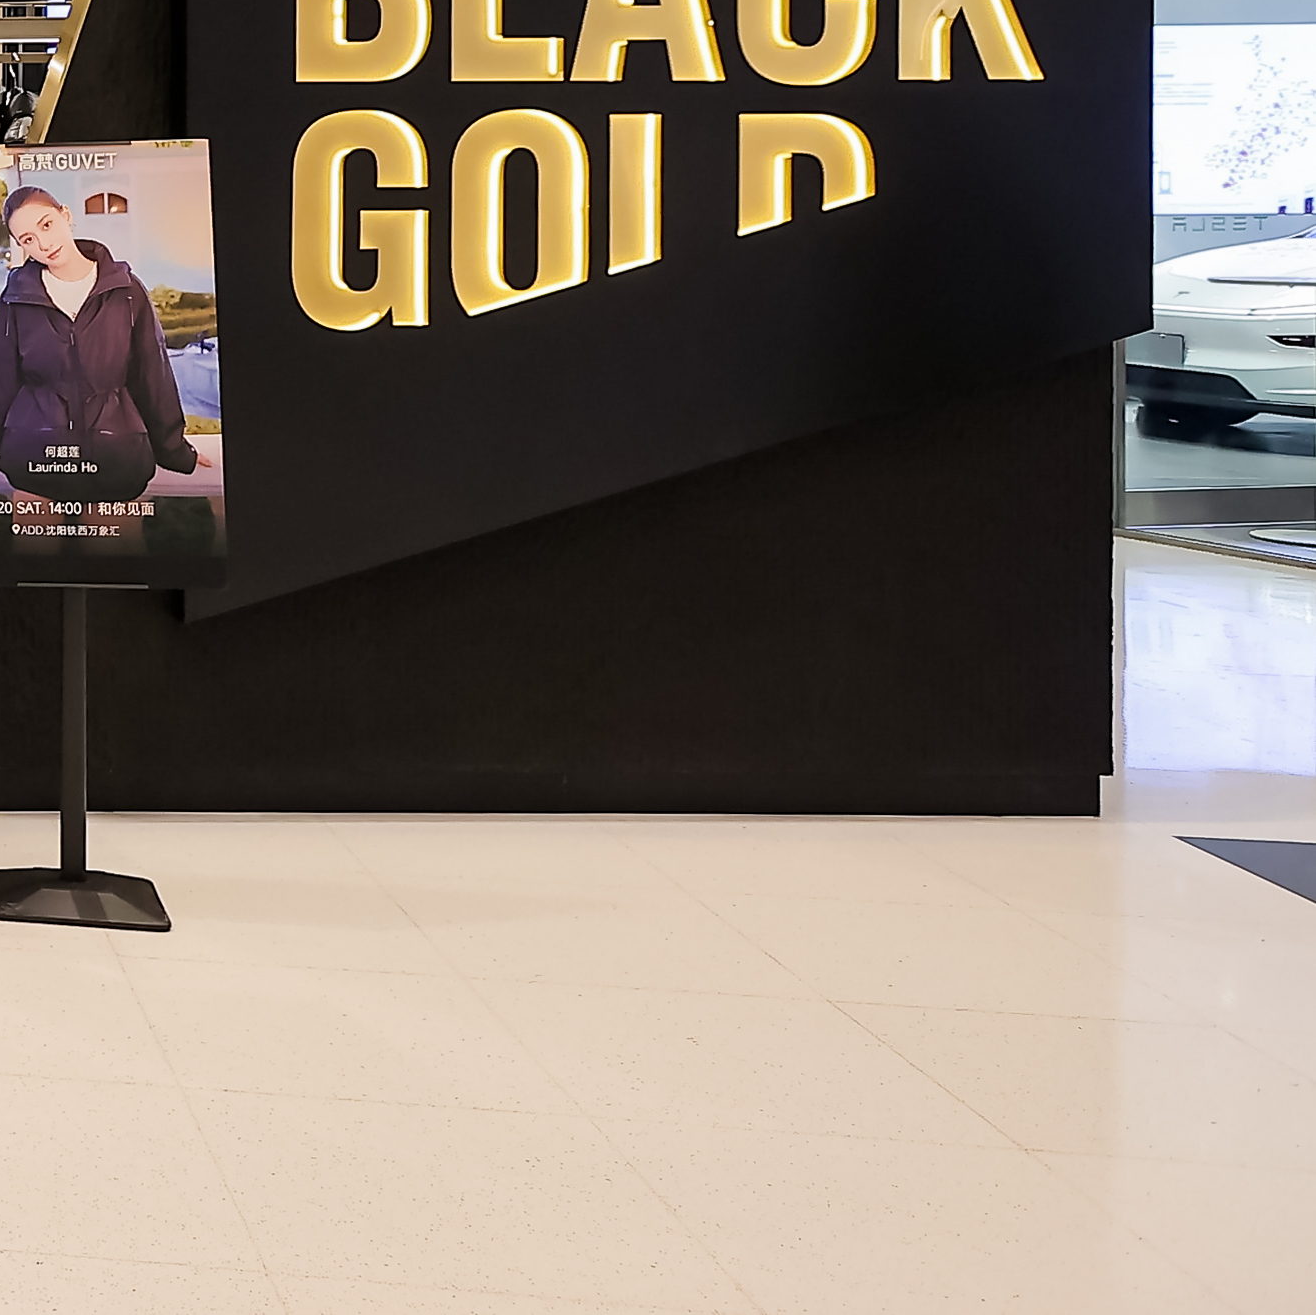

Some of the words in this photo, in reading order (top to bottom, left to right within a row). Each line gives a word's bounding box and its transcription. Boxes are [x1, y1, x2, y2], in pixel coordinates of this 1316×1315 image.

[18, 152, 53, 172] 高梵
[55, 152, 118, 170] GUVET
[44, 446, 80, 458] 何超莲
[28, 461, 78, 473] Laurinda
[81, 461, 98, 473] Ho
[16, 502, 45, 515] SAT.
[49, 502, 82, 515] 14:00
[97, 501, 155, 516] 和你见面
